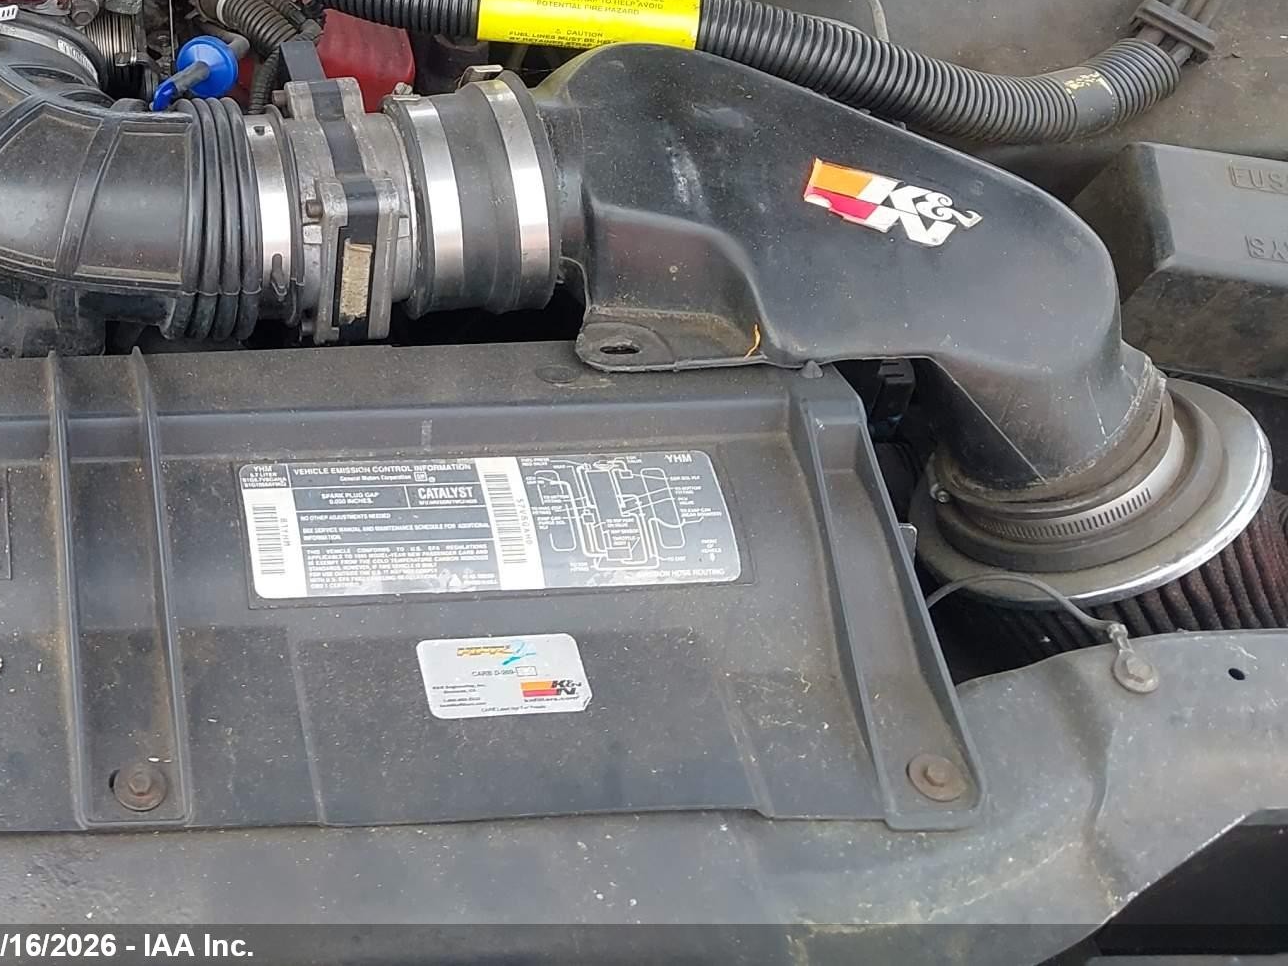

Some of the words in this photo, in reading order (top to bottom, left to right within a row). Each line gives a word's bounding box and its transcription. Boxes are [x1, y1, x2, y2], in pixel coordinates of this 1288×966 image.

[537, 0, 581, 9] POTENTIAL
[664, 454, 692, 463] YHM
[414, 464, 472, 472] INFORMATION
[417, 487, 473, 499] CATALYST
